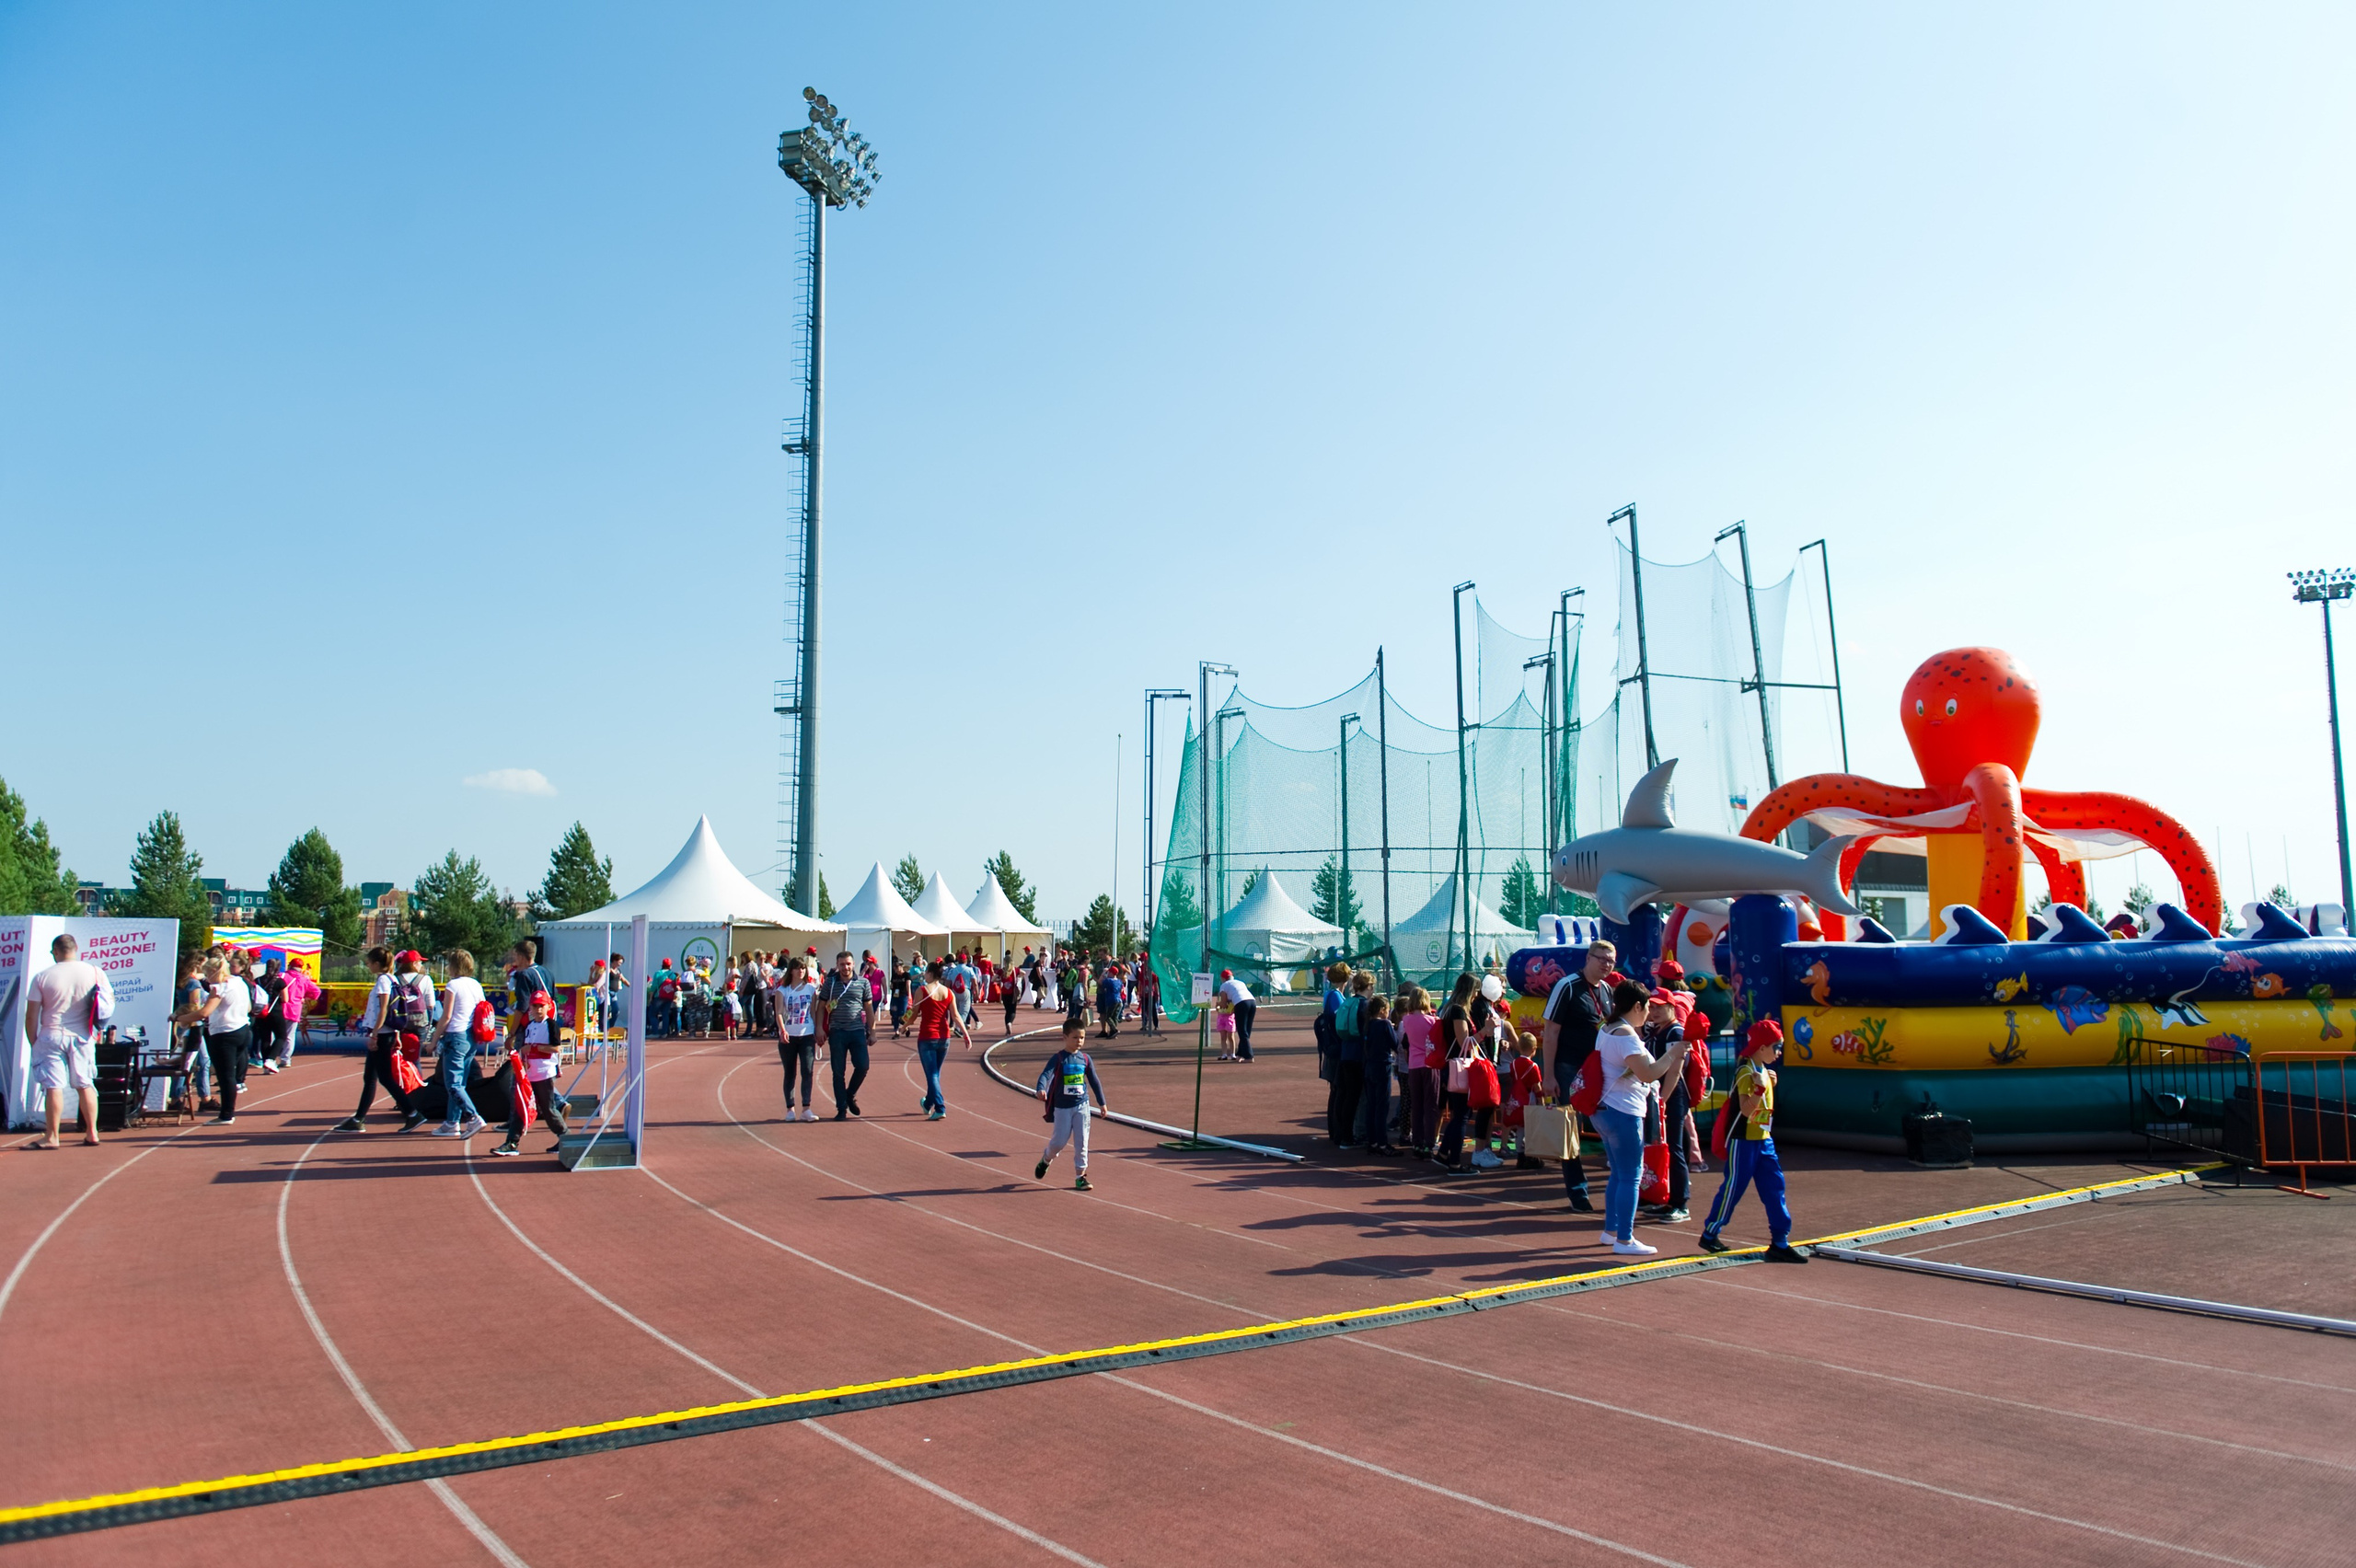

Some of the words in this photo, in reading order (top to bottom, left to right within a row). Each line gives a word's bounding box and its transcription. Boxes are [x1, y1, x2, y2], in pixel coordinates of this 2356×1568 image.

[0, 930, 25, 942] UT
[89, 931, 149, 948] BEAUTY
[0, 943, 24, 954] ON
[80, 942, 156, 961] FANZONE!
[1, 957, 16, 967] 18
[101, 958, 133, 971] 2018
[110, 977, 142, 988] БИРАЙ
[113, 983, 154, 996] ЫШНЫЙ
[114, 995, 133, 1003] РАЗ!
